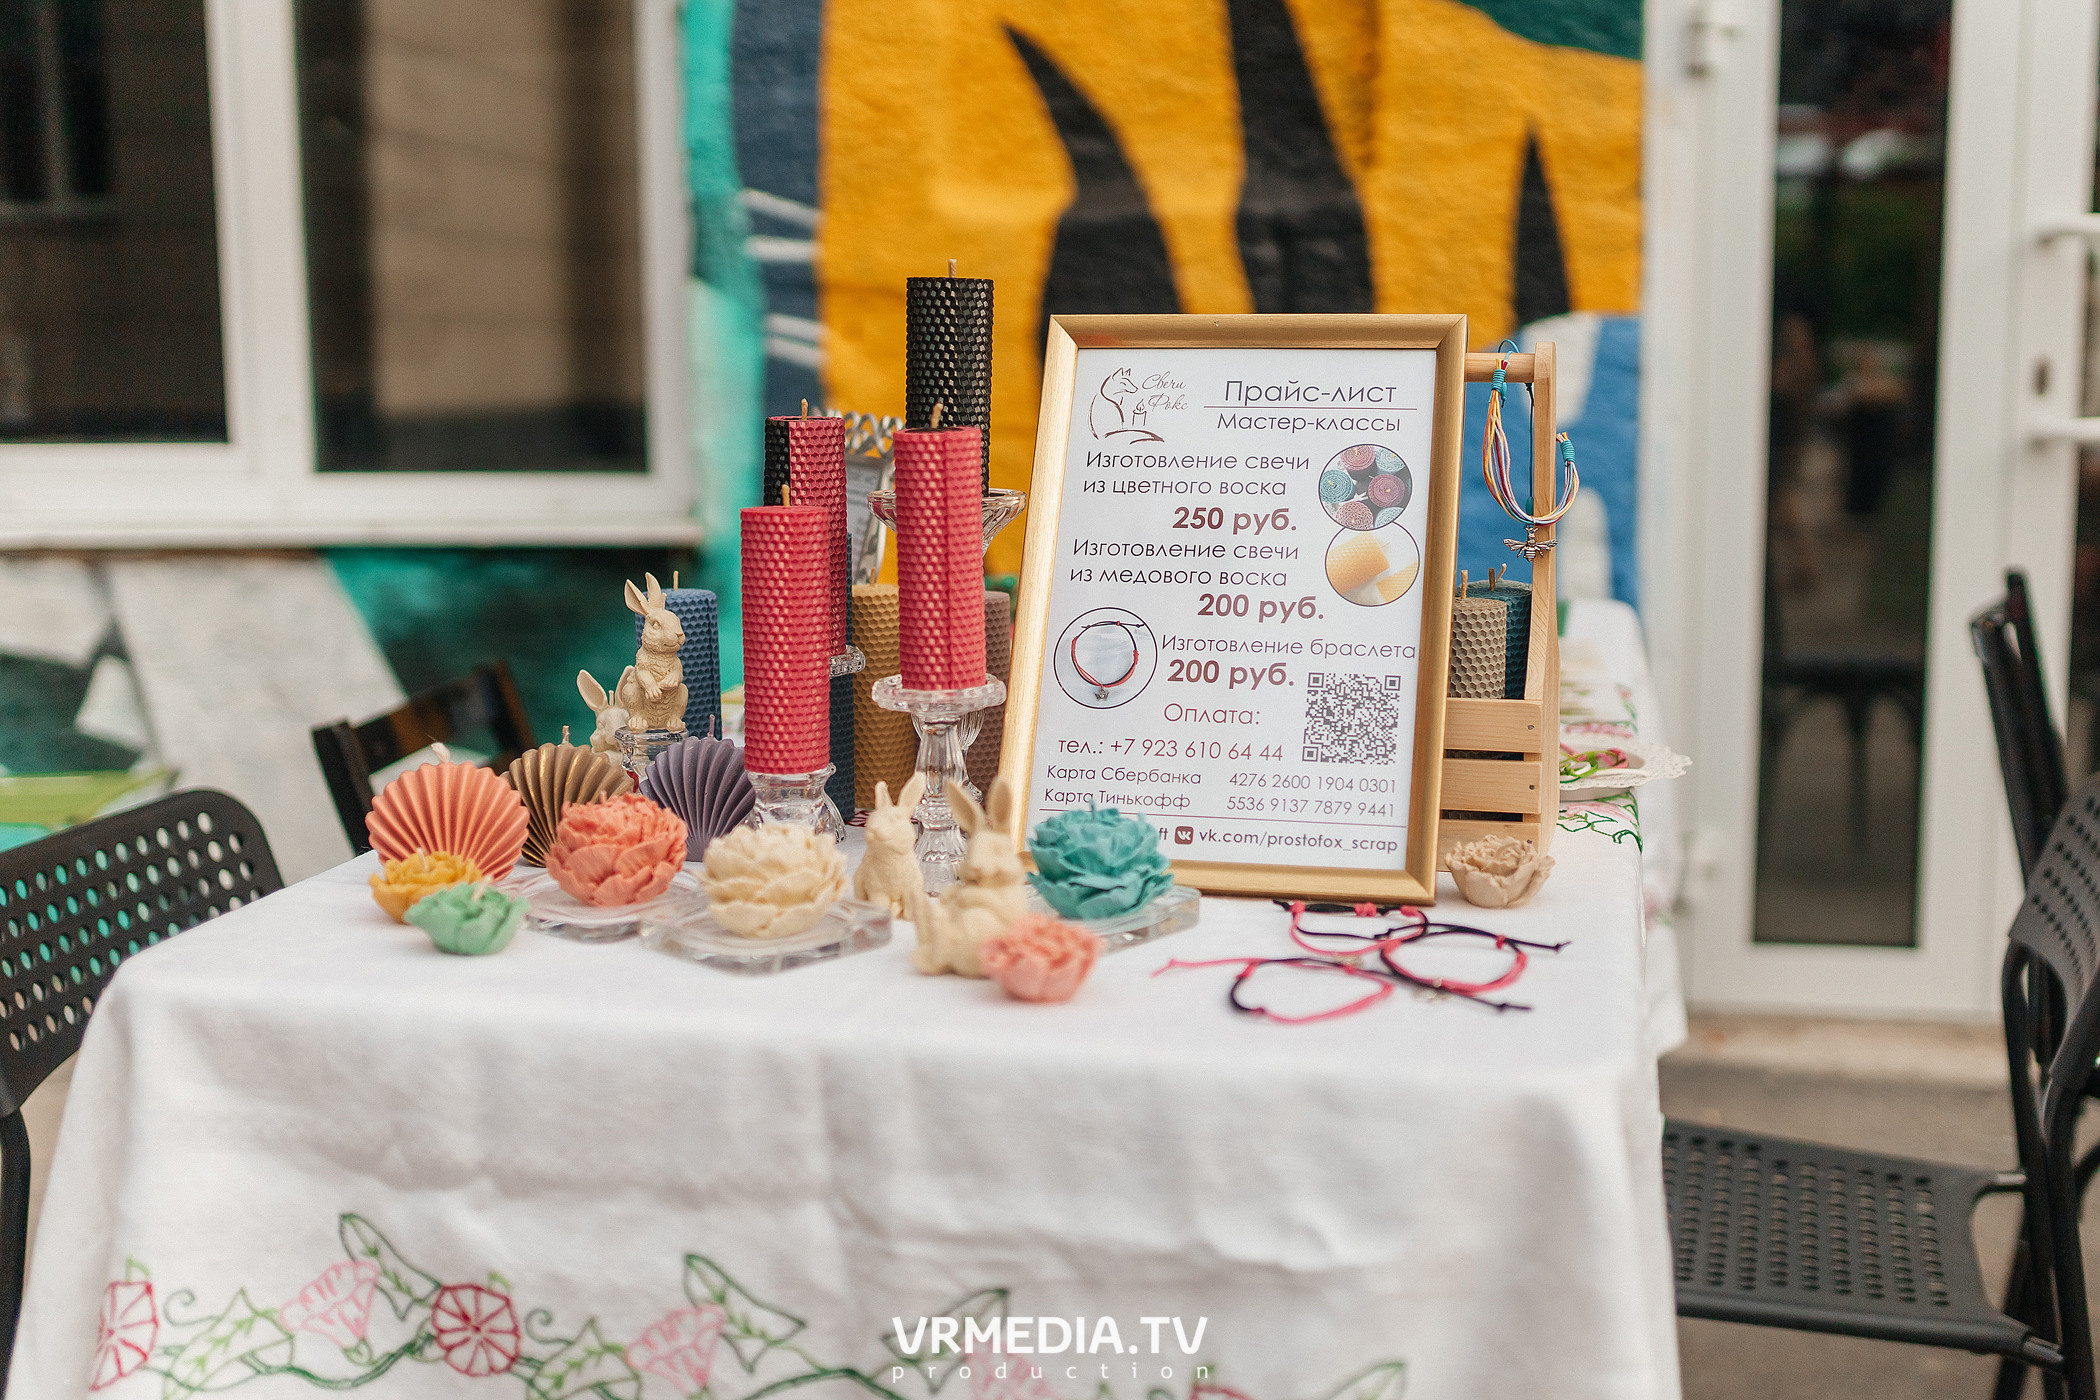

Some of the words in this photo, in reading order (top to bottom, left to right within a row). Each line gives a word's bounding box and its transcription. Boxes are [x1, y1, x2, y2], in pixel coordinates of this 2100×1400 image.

[1141, 370, 1187, 390] Свечи
[1224, 379, 1397, 405] Прайс-лист
[1148, 393, 1189, 412] Фокс
[1217, 413, 1401, 433] Мастер-классы
[1086, 450, 1238, 469] Изготовление
[1244, 455, 1310, 470] свечи
[1083, 479, 1106, 494] из
[1112, 480, 1212, 496] цветного
[1219, 481, 1287, 496] воска
[1171, 506, 1224, 530] 250
[1232, 507, 1297, 536] руб.
[1073, 538, 1226, 559] Изготовление
[1233, 545, 1299, 560] свечи
[1069, 568, 1093, 583] из
[1098, 569, 1212, 585] медового
[1219, 571, 1287, 587] воска
[1196, 592, 1250, 618] 200
[1258, 595, 1324, 624] руб.
[1161, 634, 1304, 655] Изготовление
[1310, 638, 1416, 660] браслета
[1167, 658, 1220, 684] 200
[1228, 661, 1295, 691] руб.
[1163, 702, 1261, 725] Оплата:
[1058, 739, 1104, 755] тел.:
[1110, 738, 1136, 756] +7
[1142, 738, 1178, 758] 923
[1184, 740, 1222, 760] 610
[1228, 742, 1252, 761] 64
[1258, 743, 1284, 762] 44
[1046, 764, 1096, 783] Карта
[1101, 766, 1202, 785] Сбербанка
[1228, 772, 1267, 788] 4276
[1271, 773, 1311, 790] 2600
[1318, 776, 1354, 792] 1904
[1358, 777, 1395, 793] 0301
[1045, 788, 1094, 805] Карта
[1099, 790, 1191, 810] Тинькофф
[1226, 795, 1265, 812] 5536
[1270, 797, 1309, 813] 9137
[1314, 799, 1353, 816] 7879
[1357, 801, 1394, 817] 9441
[1198, 828, 1398, 855] vk.com/prostofox_scrap
